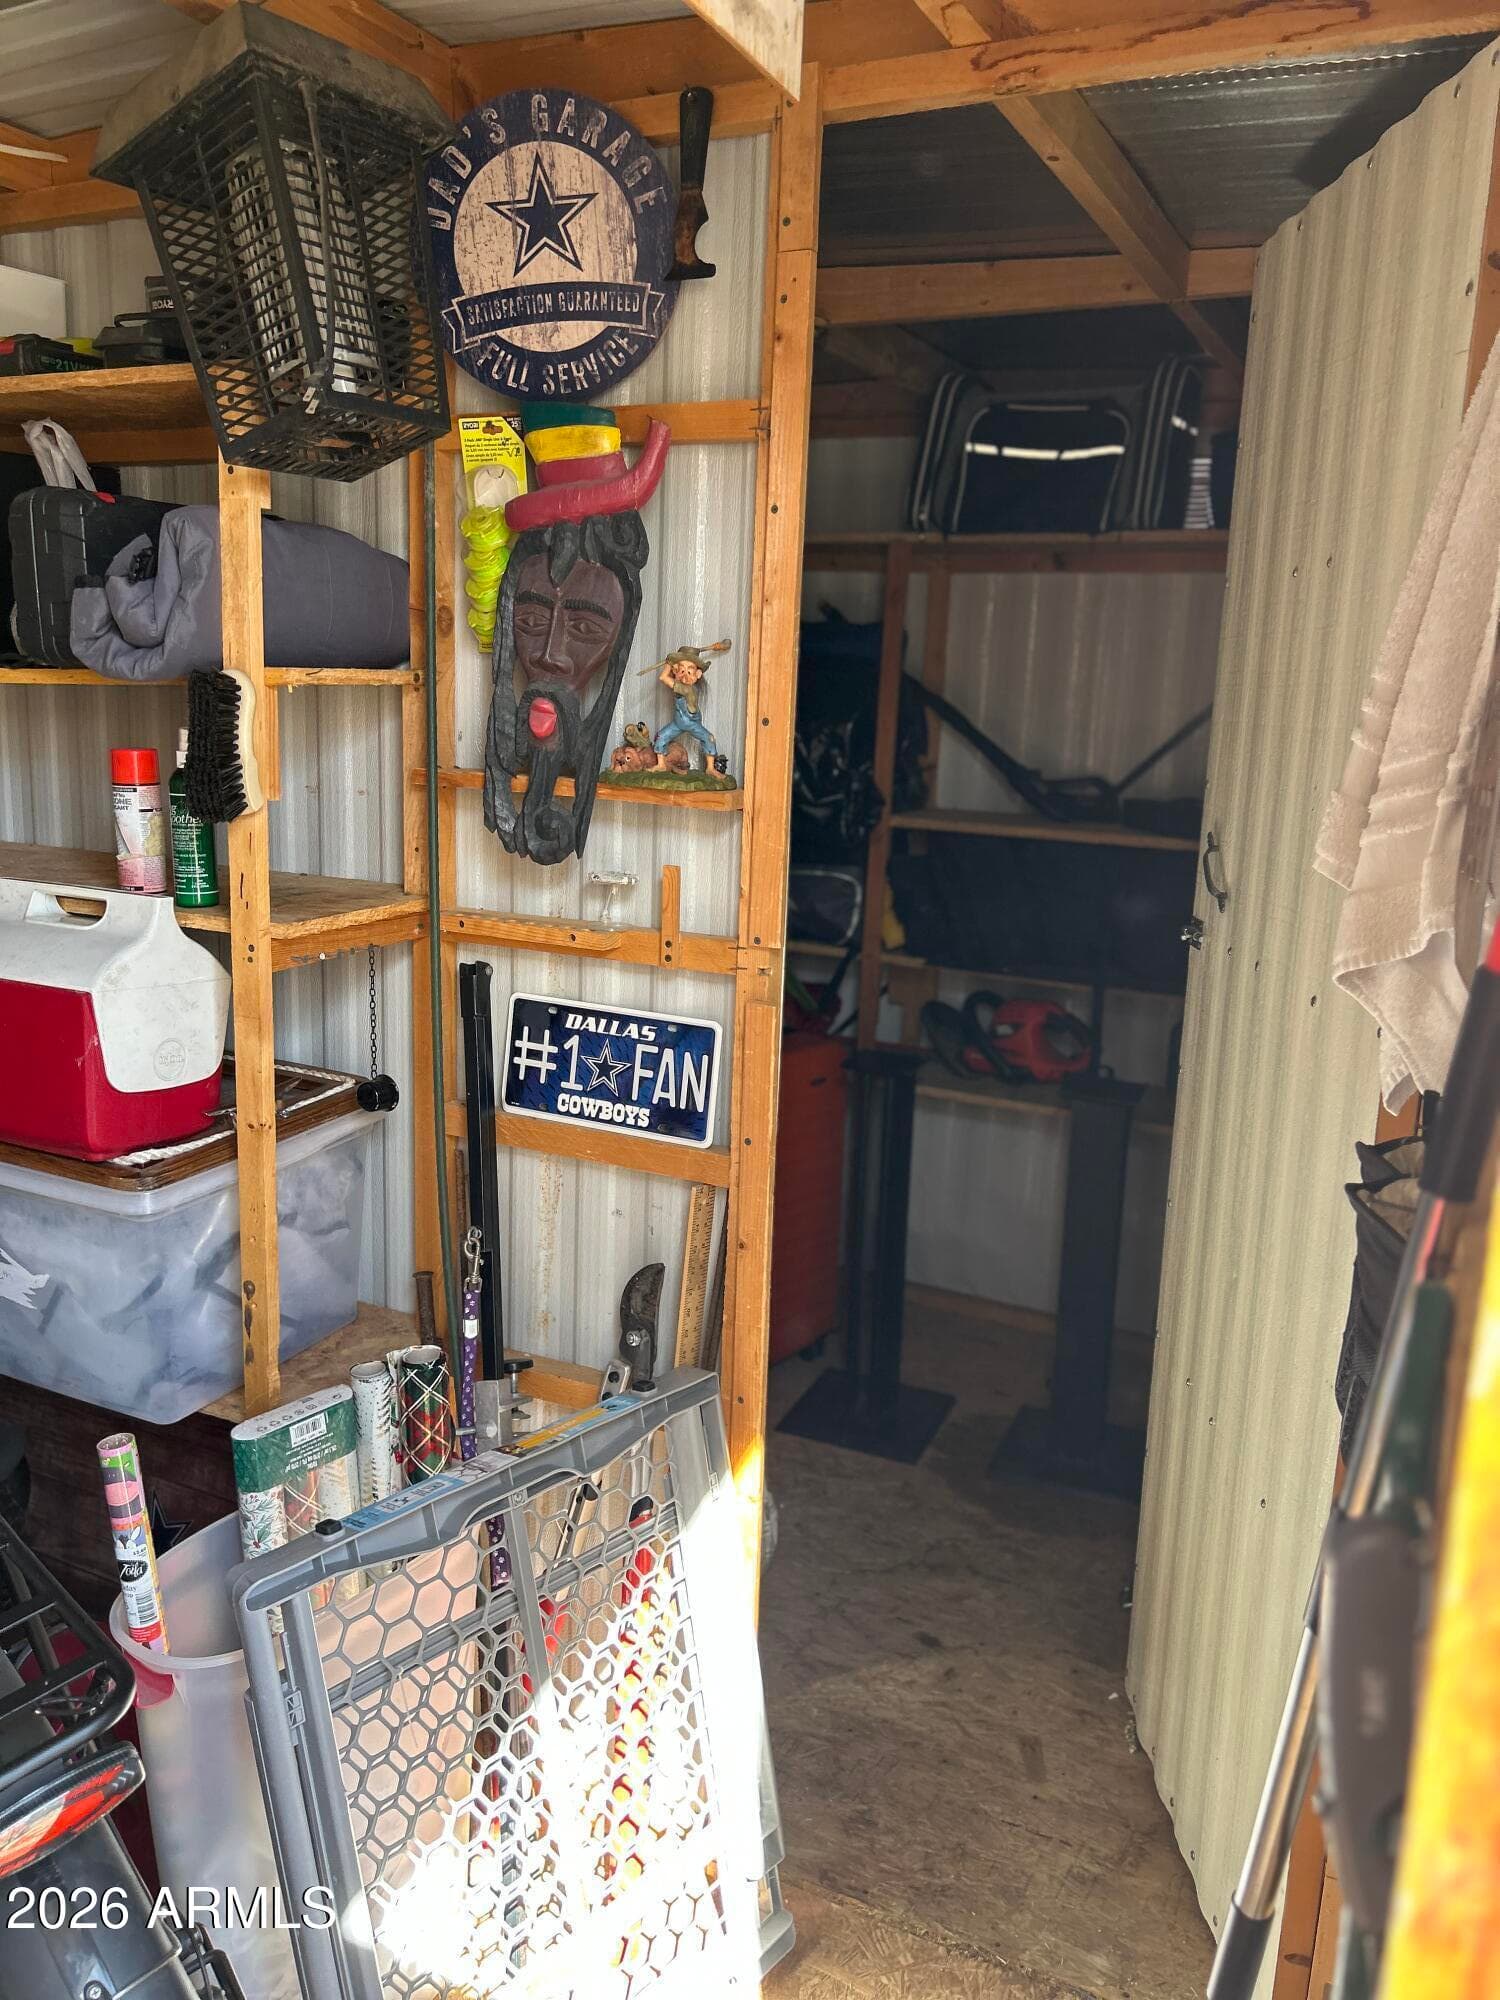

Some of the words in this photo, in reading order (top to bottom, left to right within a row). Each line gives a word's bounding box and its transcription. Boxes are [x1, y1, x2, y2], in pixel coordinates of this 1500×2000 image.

[427, 108, 507, 231] DAD'S
[531, 94, 668, 214] GARAGE
[466, 293, 552, 325] SATISFACTION
[558, 291, 640, 313] GUARANTEED
[477, 342, 530, 393] FULL
[543, 329, 640, 395] SERVICE
[565, 1013, 658, 1042] DALLAS
[513, 1026, 584, 1091] #1
[631, 1043, 709, 1113] FAN
[557, 1093, 650, 1128] COWBOYS
